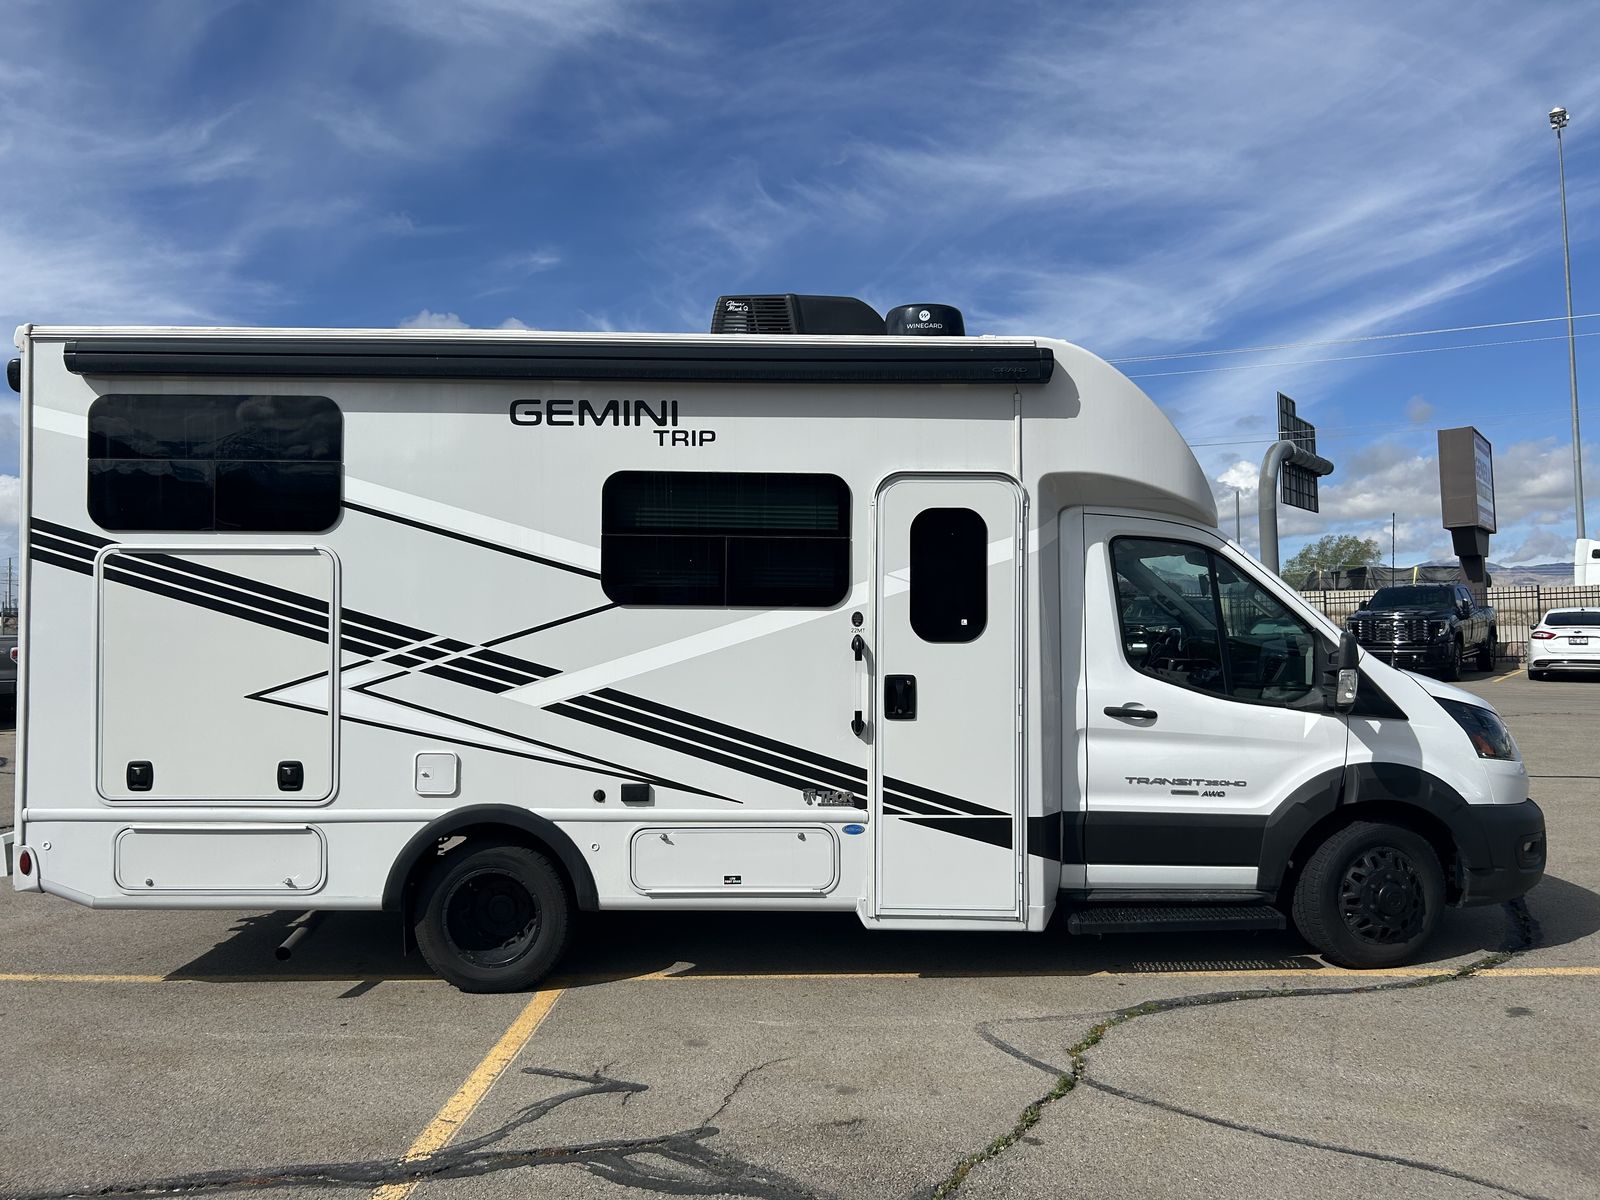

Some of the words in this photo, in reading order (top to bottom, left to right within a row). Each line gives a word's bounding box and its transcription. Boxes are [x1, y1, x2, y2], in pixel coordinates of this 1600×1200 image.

[509, 399, 679, 427] GEMINI
[653, 430, 716, 447] TRIP
[1200, 790, 1226, 798] AWD
